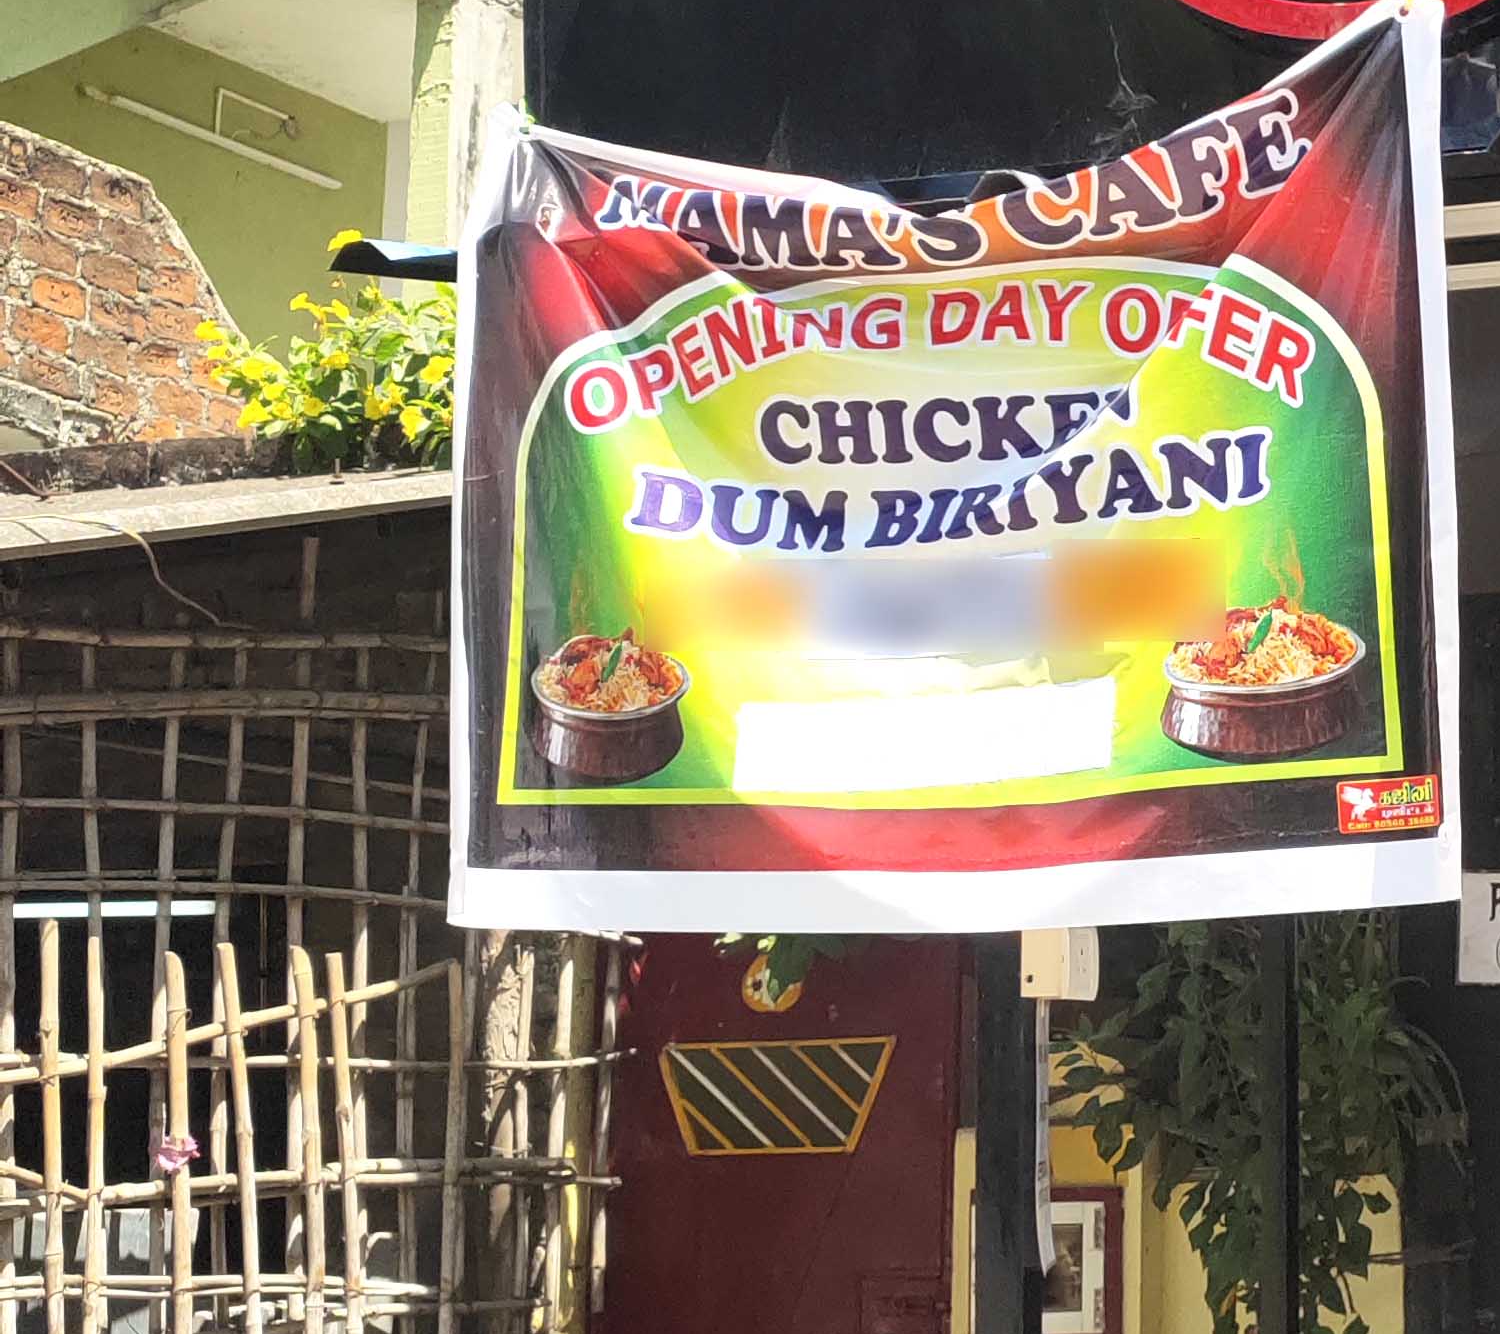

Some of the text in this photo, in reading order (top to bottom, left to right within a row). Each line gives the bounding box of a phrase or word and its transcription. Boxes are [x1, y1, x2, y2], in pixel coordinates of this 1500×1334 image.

[600, 92, 1310, 269] MAMA'S CAFE
[568, 296, 904, 430] OPENING
[929, 283, 1088, 347] DAY
[630, 431, 1268, 553] DUM BIRIYANI
